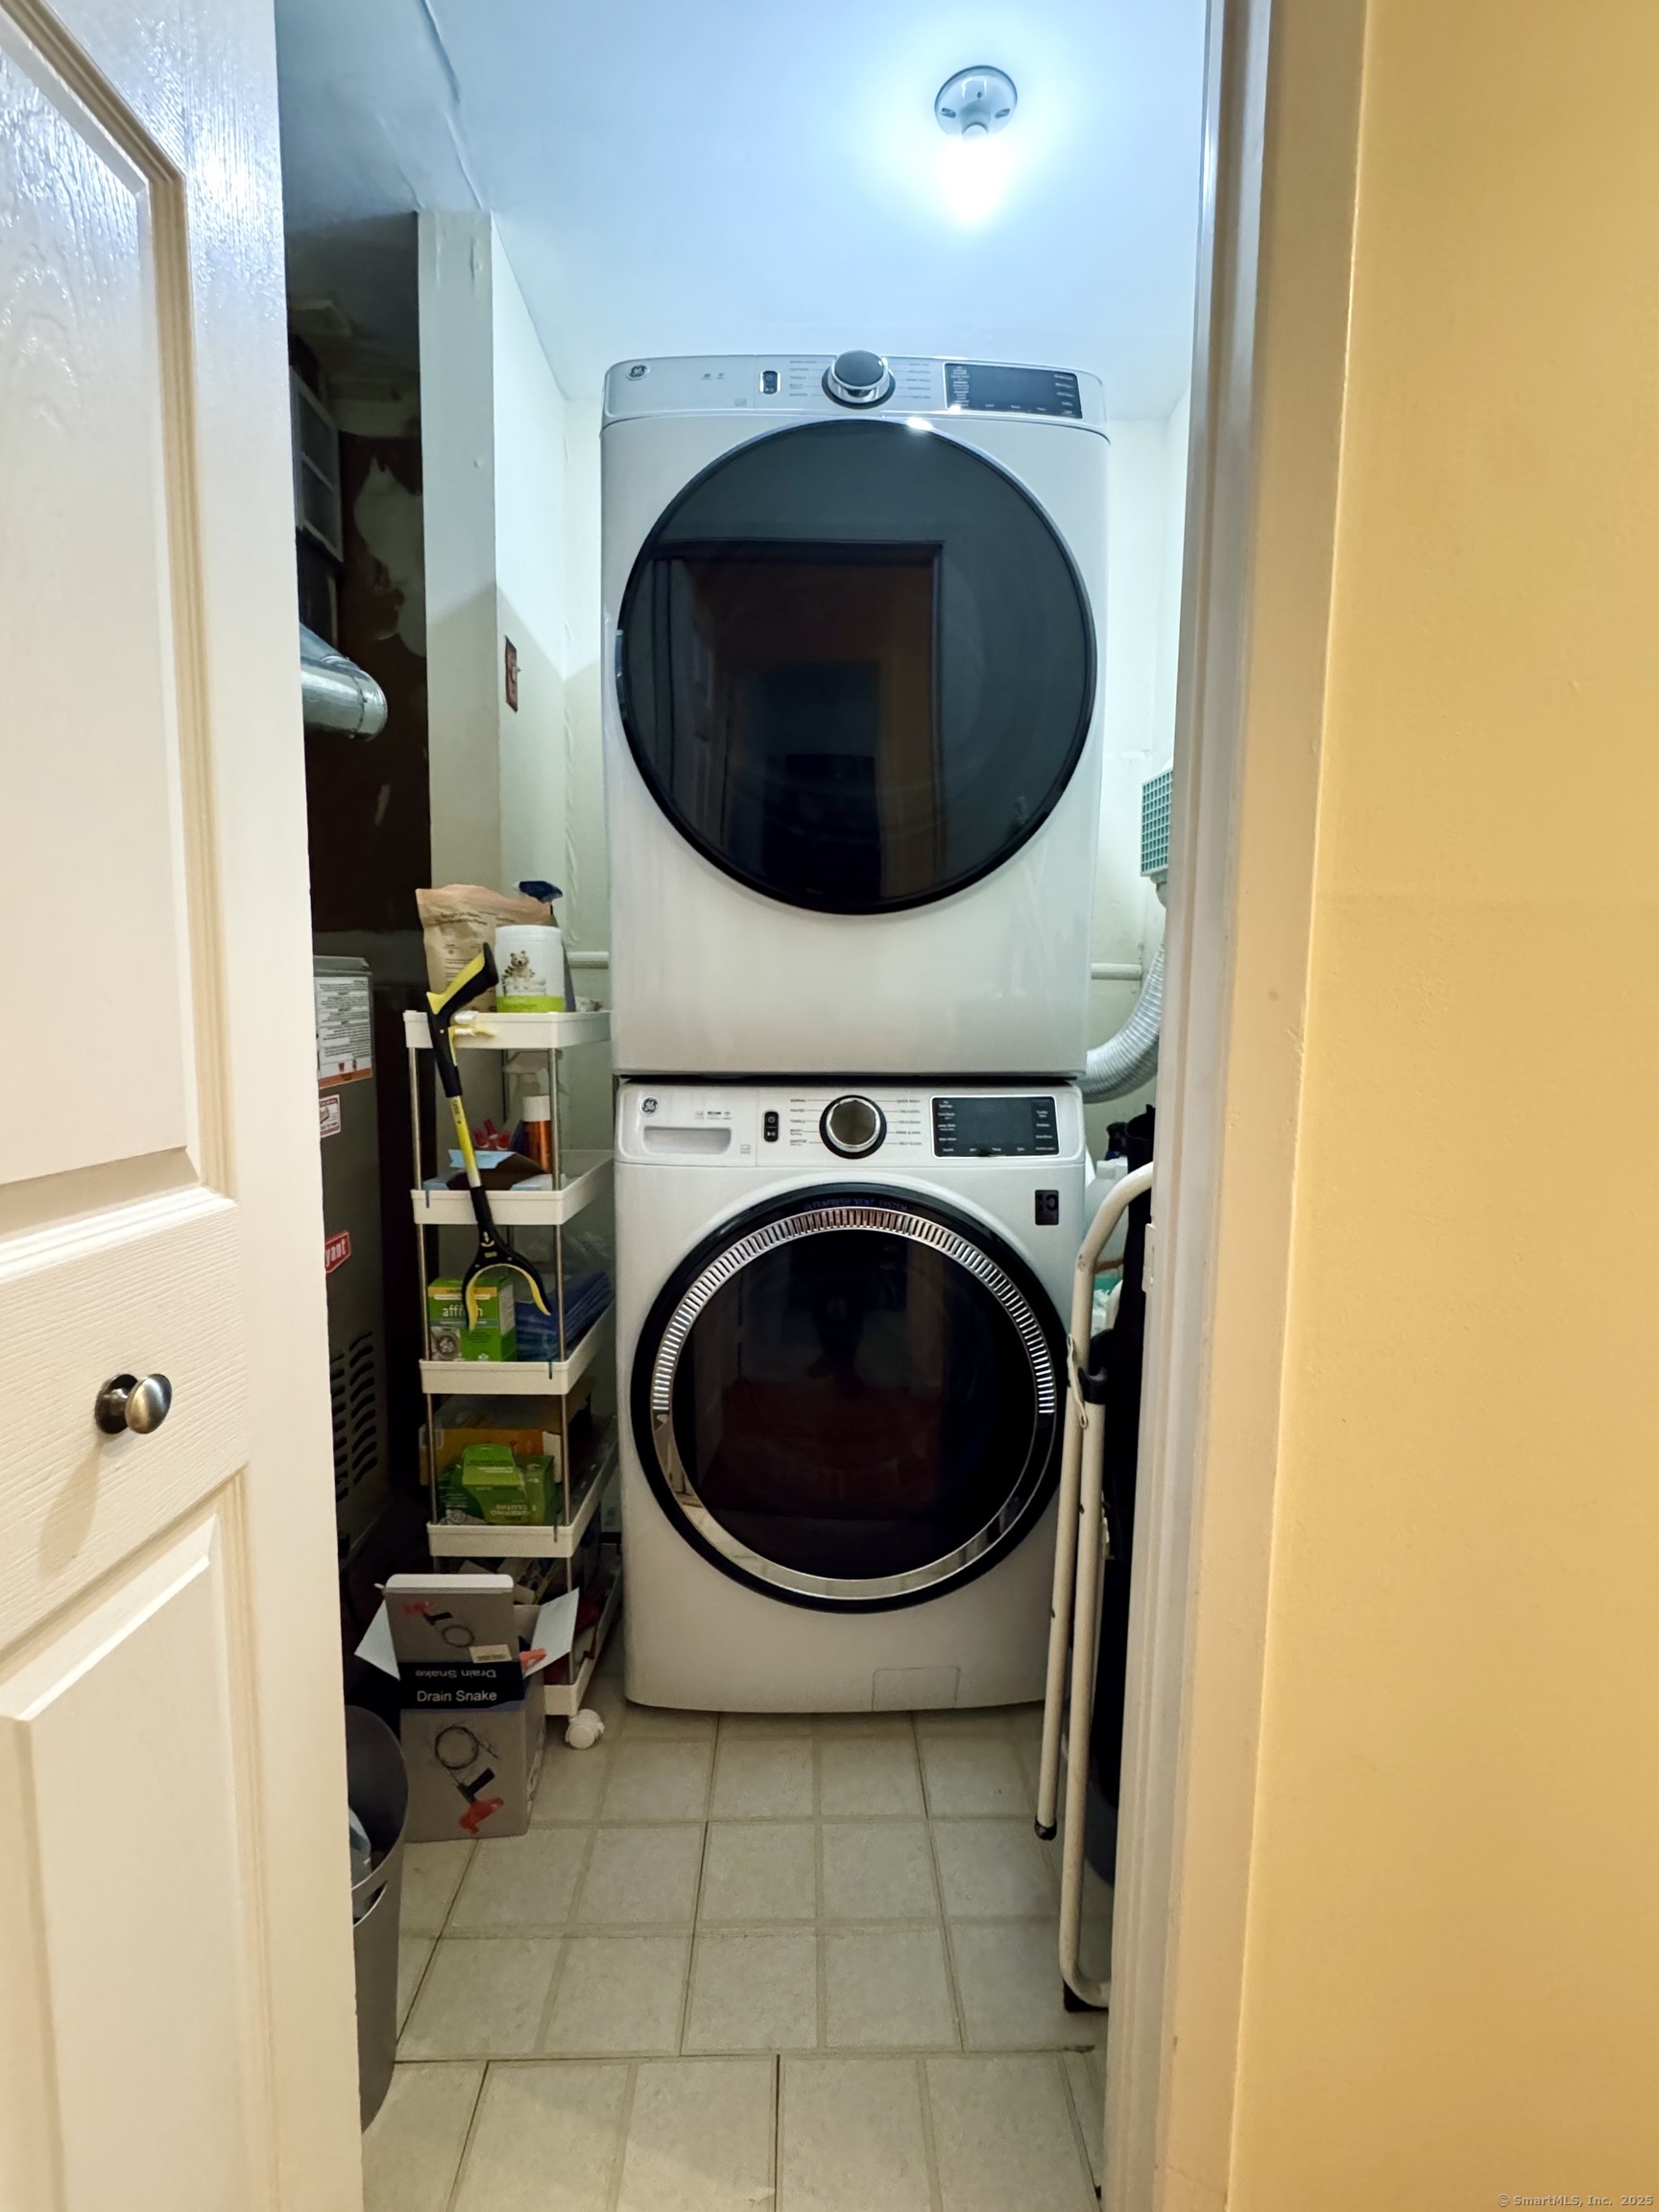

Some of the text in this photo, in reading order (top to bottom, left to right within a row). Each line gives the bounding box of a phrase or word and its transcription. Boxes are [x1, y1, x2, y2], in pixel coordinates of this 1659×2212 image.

[415, 1669, 497, 1678] Drain Snake
[417, 1689, 498, 1702] Drain Snake
